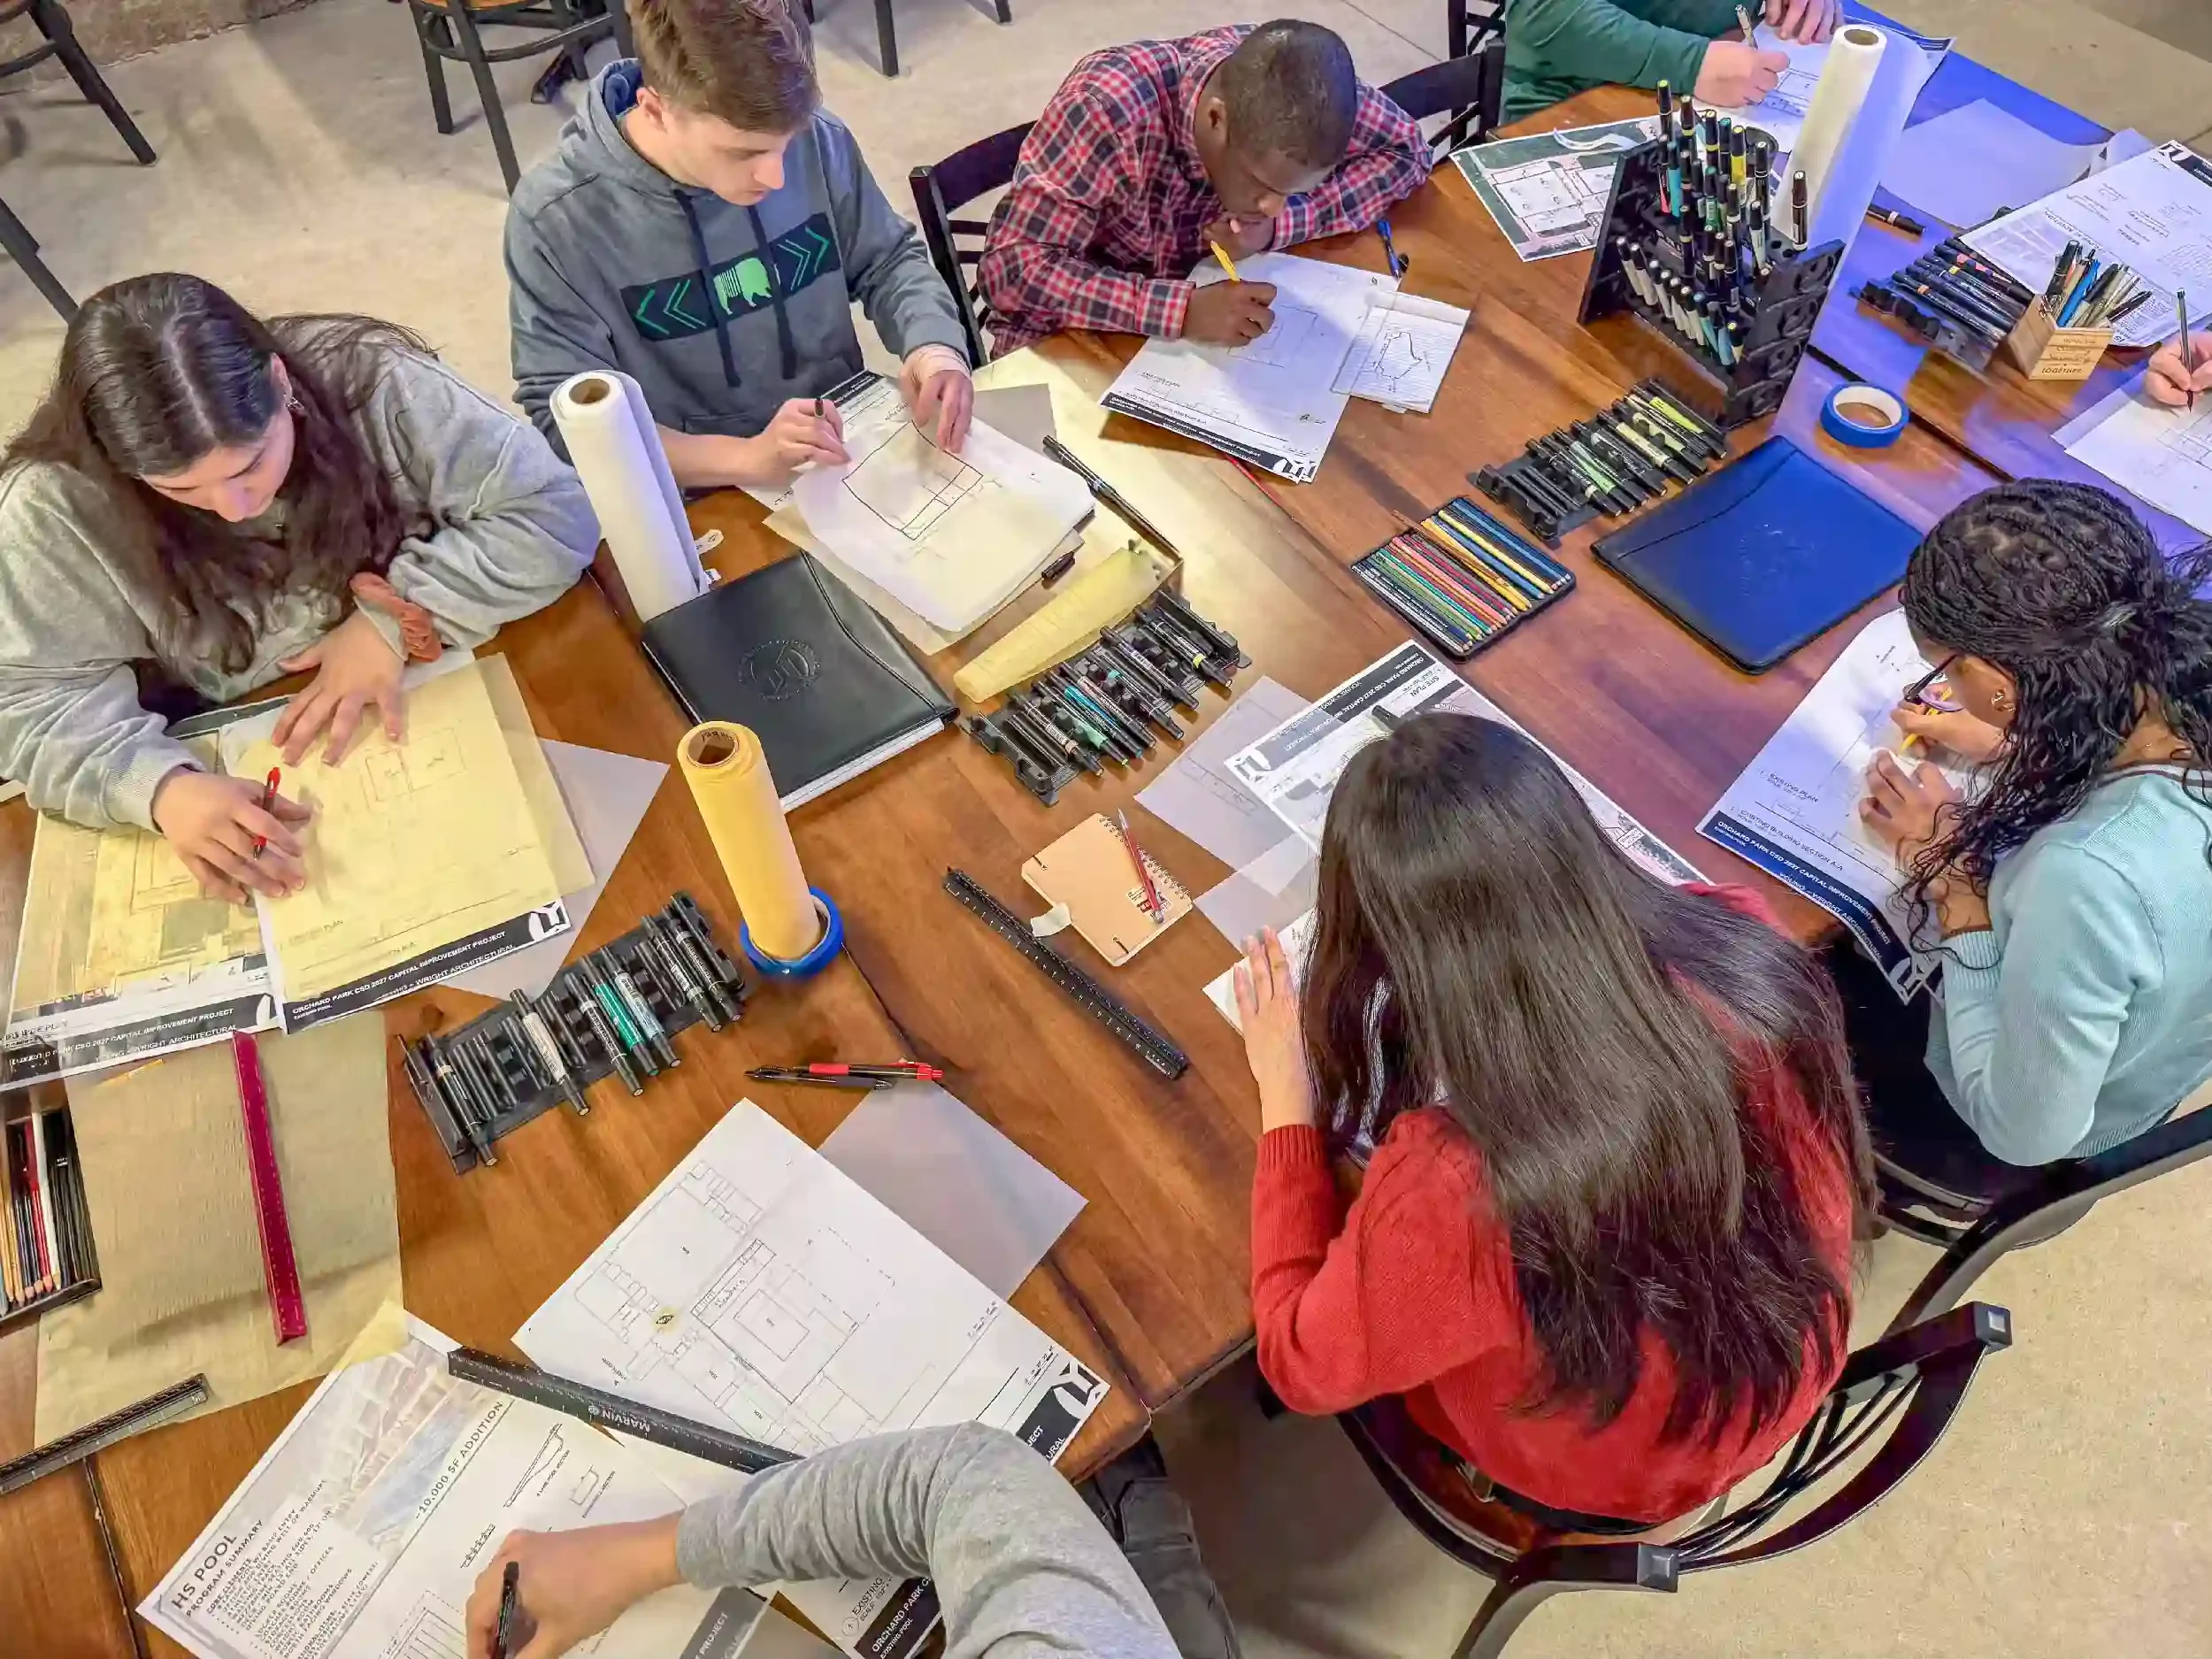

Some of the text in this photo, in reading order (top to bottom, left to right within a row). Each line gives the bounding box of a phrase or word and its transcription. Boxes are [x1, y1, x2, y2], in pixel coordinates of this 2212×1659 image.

[1717, 820, 1750, 842] ORCHARD
[1748, 839, 1769, 854] PARK
[1768, 849, 1784, 862] CSD
[1798, 867, 1827, 887] CAPITAL
[1810, 891, 1841, 914] WRIGHT
[291, 996, 331, 1015] ORCHARD
[331, 988, 354, 1002] PARK
[353, 983, 371, 994] CSD
[387, 964, 418, 980] CAPITAL
[418, 942, 472, 968] IMPROVEMENT
[471, 930, 506, 948] PROJECT
[414, 969, 449, 986] WRIGHT
[142, 1016, 196, 1035] IMPROVEMENT
[197, 1007, 234, 1022] PROJECT
[167, 1022, 239, 1046] ARCHITECTURAL
[447, 1457, 461, 1473] SF
[457, 1399, 504, 1458] ADDITION
[600, 1409, 651, 1432] MARVIN
[1025, 1425, 1044, 1447] JECT
[171, 1533, 237, 1610] HS POOL
[186, 1569, 226, 1617] PROGRAM
[225, 1519, 264, 1567] SUMMARY
[851, 1576, 884, 1616] EXISTING
[698, 1611, 729, 1655] PROJECT
[870, 1609, 906, 1653] ORCHARD
[902, 1585, 924, 1610] PARK
[878, 1616, 913, 1659] EXISTING POOL
